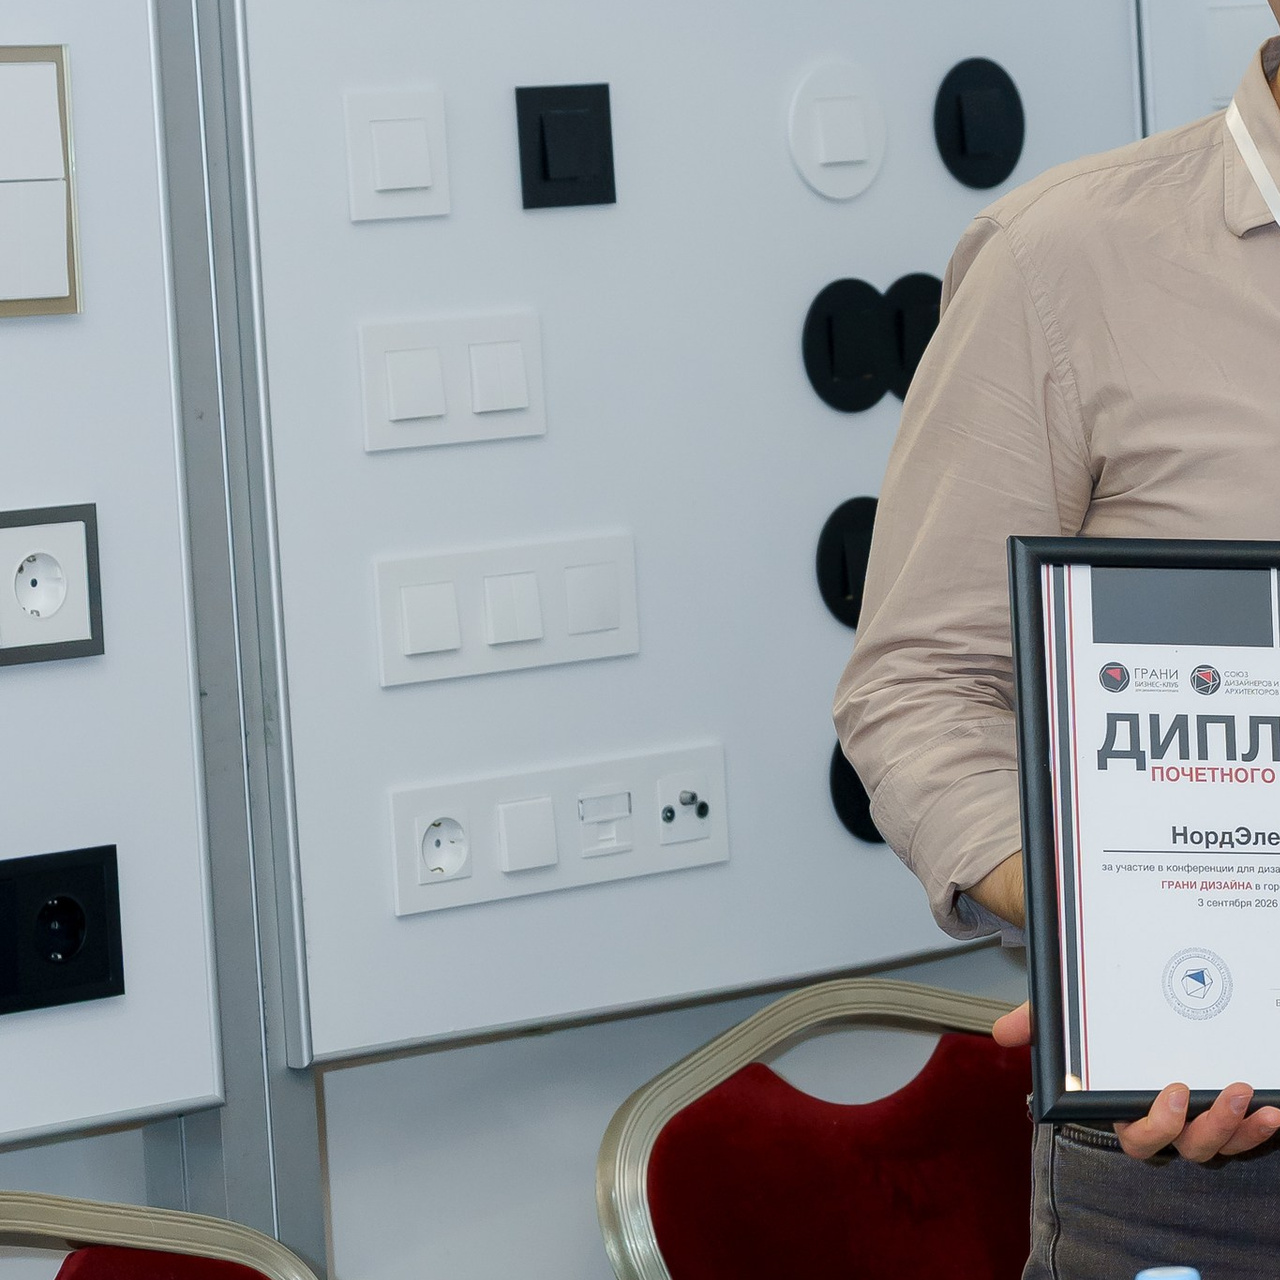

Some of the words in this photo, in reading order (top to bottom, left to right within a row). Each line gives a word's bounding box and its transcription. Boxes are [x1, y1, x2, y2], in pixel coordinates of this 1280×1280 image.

[1134, 667, 1179, 680] ГРАНИ
[1223, 670, 1249, 678] СОЮЗ
[1134, 681, 1179, 689] БИЗНЕС-КЛУБ
[1223, 679, 1273, 688] ДИЗАЙНЕРОВ
[1224, 688, 1280, 696] АРХИТЕКТОРОВ
[1151, 765, 1276, 784] ПОЧЕТНОГО
[1102, 863, 1113, 872] за
[1115, 864, 1156, 874] участие
[1166, 864, 1234, 875] конференции
[1236, 865, 1256, 874] для
[1161, 880, 1198, 890] ГРАНИ
[1199, 880, 1253, 892] ДИЗАЙНА
[1197, 899, 1204, 908] 3
[1206, 899, 1252, 909] сентября
[1254, 899, 1278, 908] 2026
